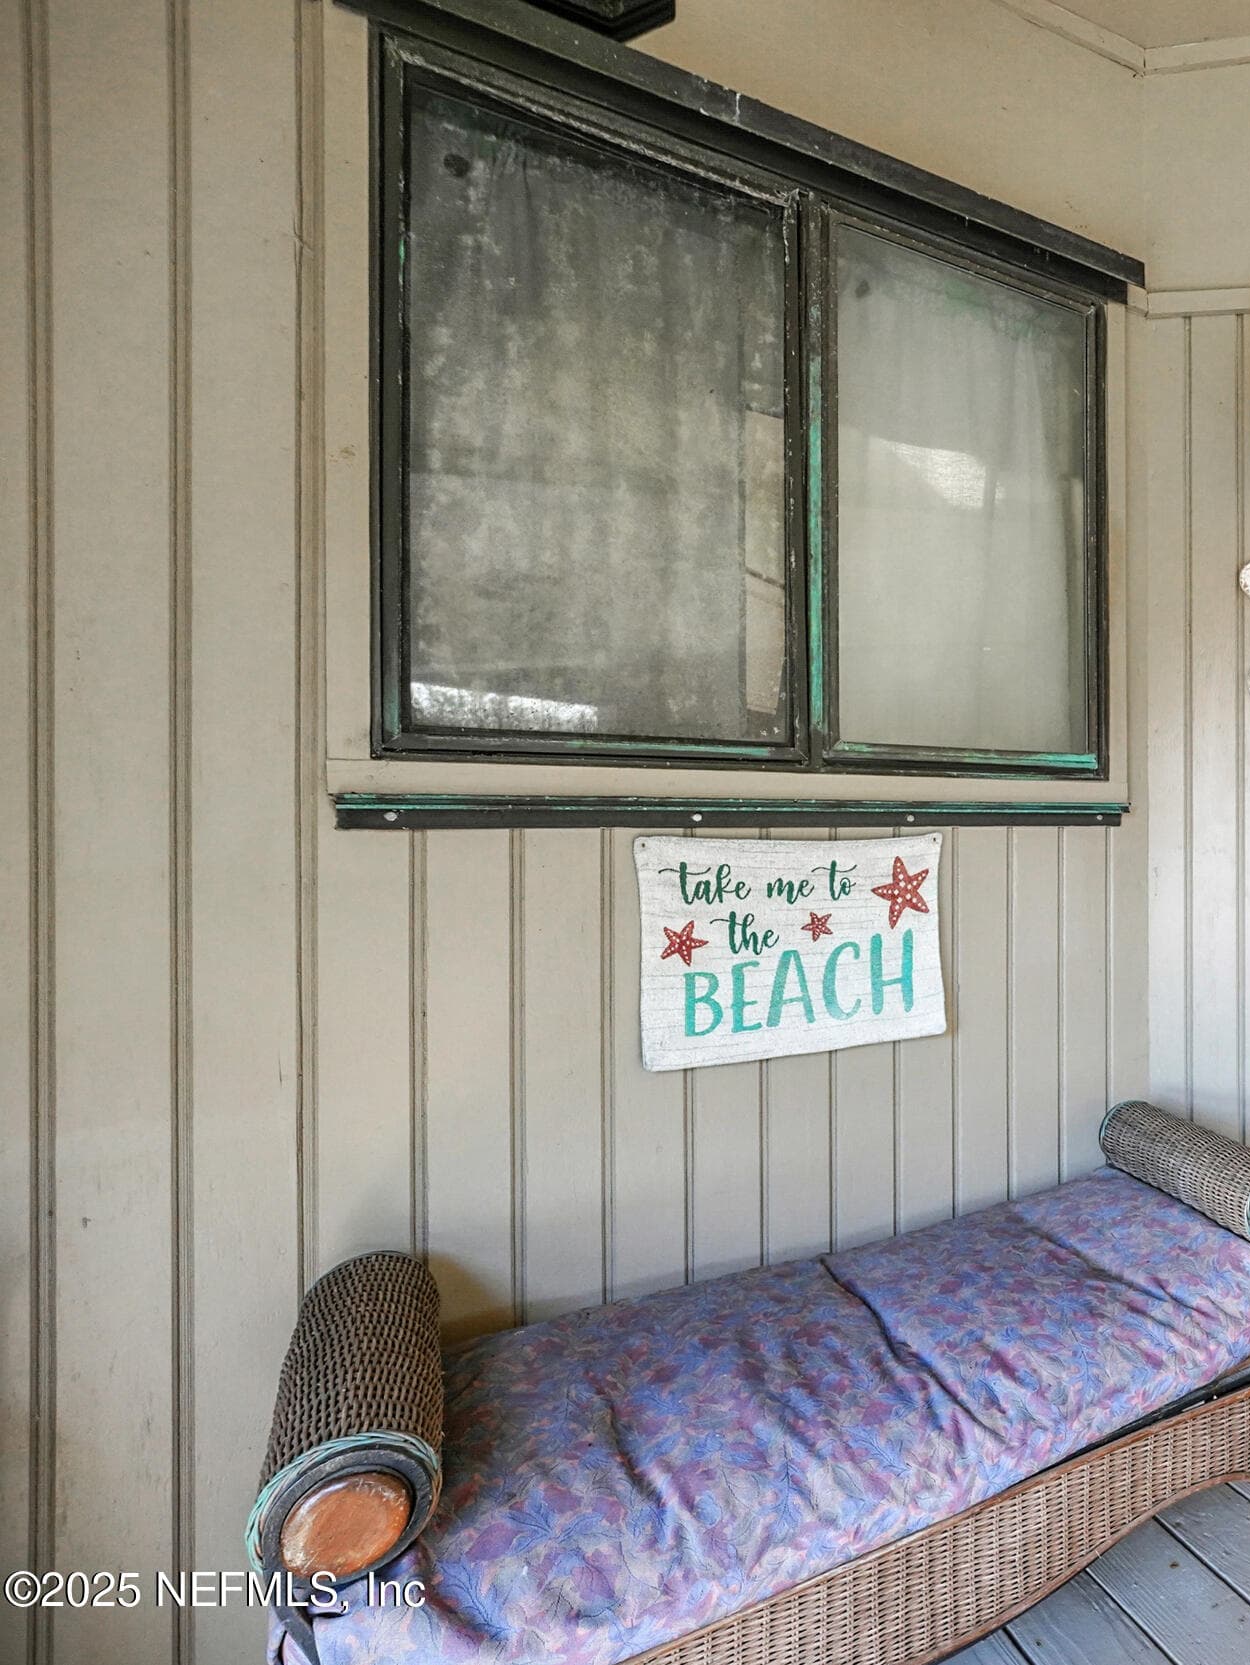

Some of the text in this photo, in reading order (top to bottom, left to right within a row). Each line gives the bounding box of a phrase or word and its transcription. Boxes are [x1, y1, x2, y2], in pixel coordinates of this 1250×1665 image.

[658, 860, 858, 906] take me to
[710, 910, 780, 956] the
[682, 927, 915, 1038] BEACH
